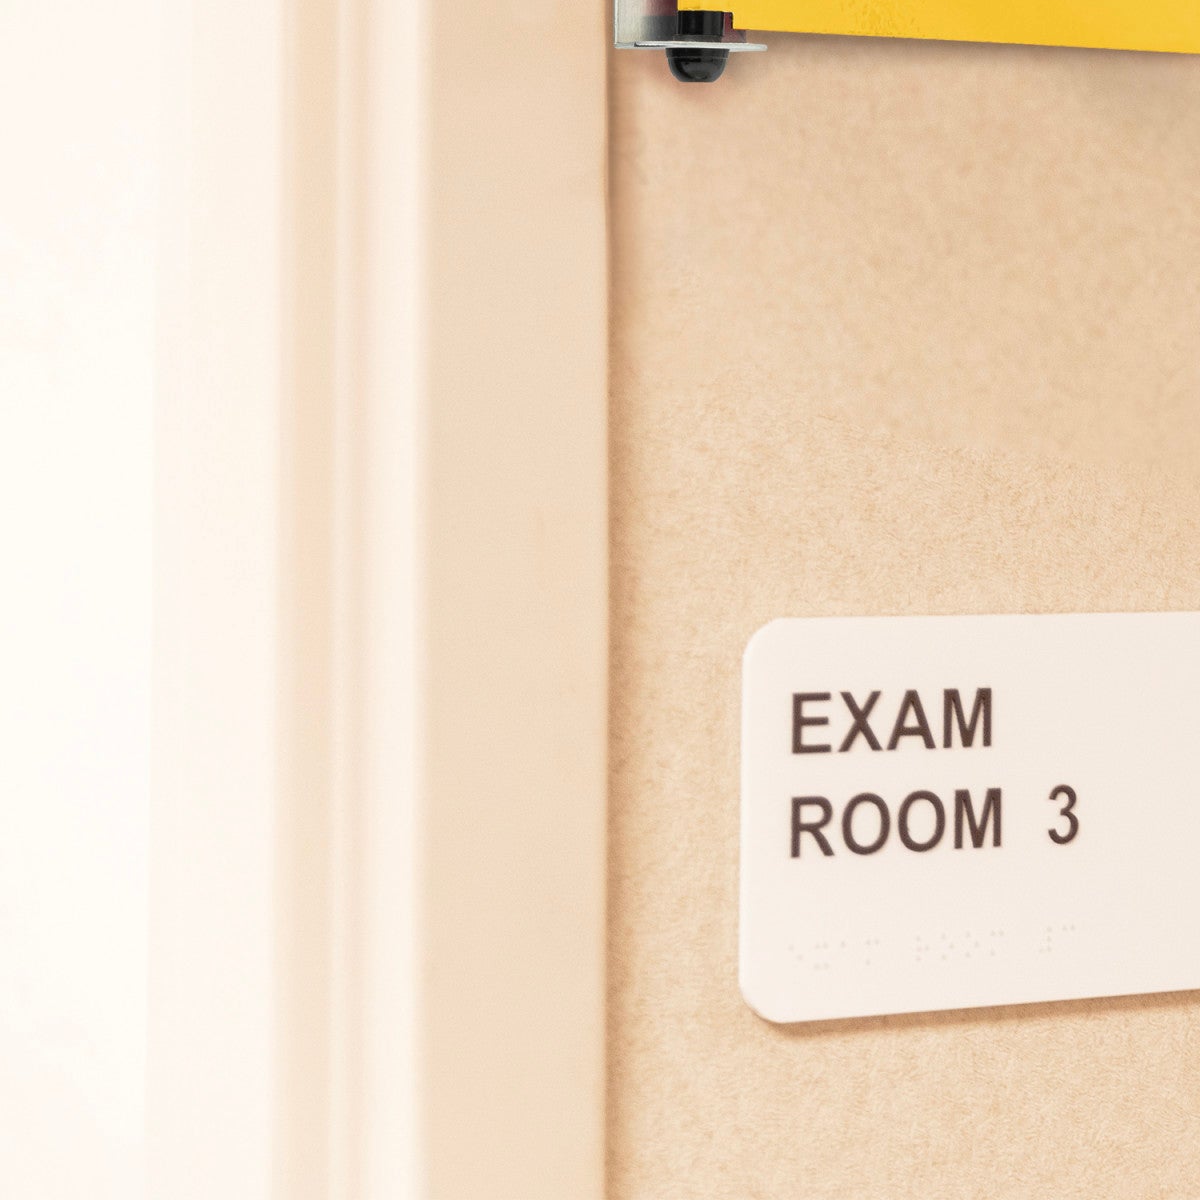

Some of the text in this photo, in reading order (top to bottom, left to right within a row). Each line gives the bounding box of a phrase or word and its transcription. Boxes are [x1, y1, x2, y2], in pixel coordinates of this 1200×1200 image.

[791, 687, 992, 754] EXAM
[790, 784, 1079, 858] ROOM 3
